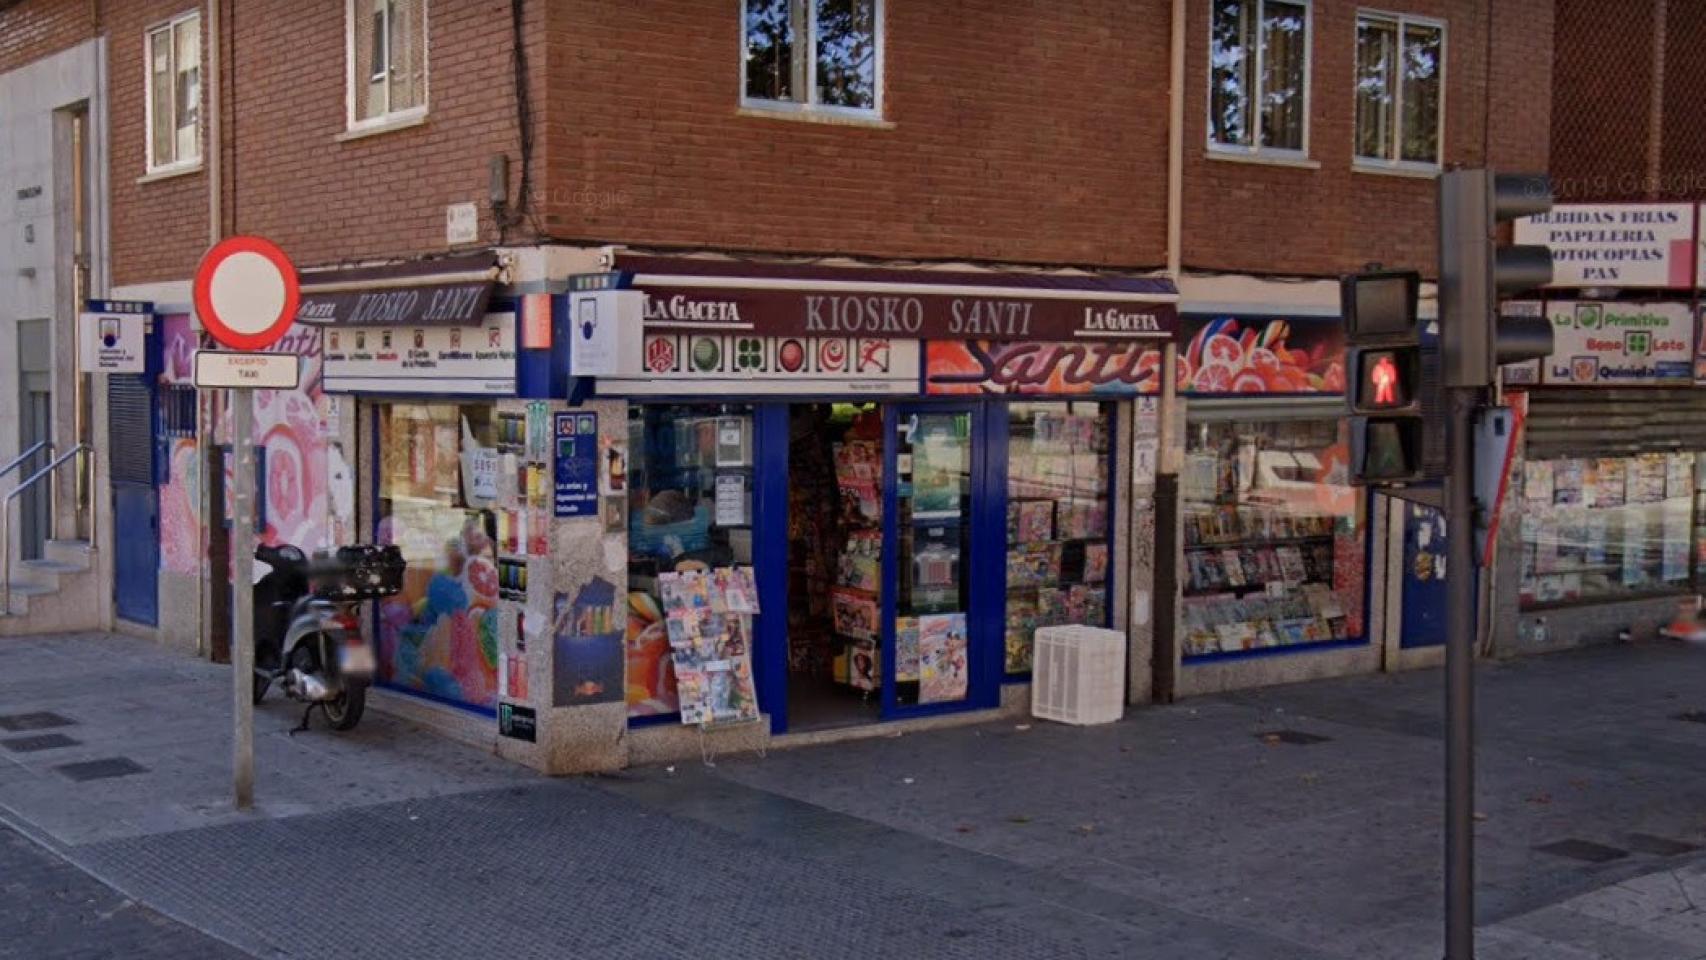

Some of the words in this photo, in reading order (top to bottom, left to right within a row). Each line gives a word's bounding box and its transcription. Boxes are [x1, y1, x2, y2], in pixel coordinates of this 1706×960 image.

[1530, 211, 1614, 224] BEBIDAS
[1620, 211, 1679, 224] FRIAS
[1550, 230, 1655, 243] PAPELERIA
[1550, 249, 1664, 261] OTOCOPIAS
[1582, 267, 1619, 280] PAX
[348, 290, 419, 321] KIOSKO
[421, 286, 486, 321] SANTI
[670, 295, 740, 321] GACETA
[805, 296, 924, 332] KIOSKO
[949, 299, 1033, 336] SANTI
[1105, 308, 1161, 331] GACETA
[1554, 313, 1572, 326] La
[1604, 312, 1669, 326] Primitiva
[239, 370, 258, 379] TAXI
[1553, 366, 1569, 377] La
